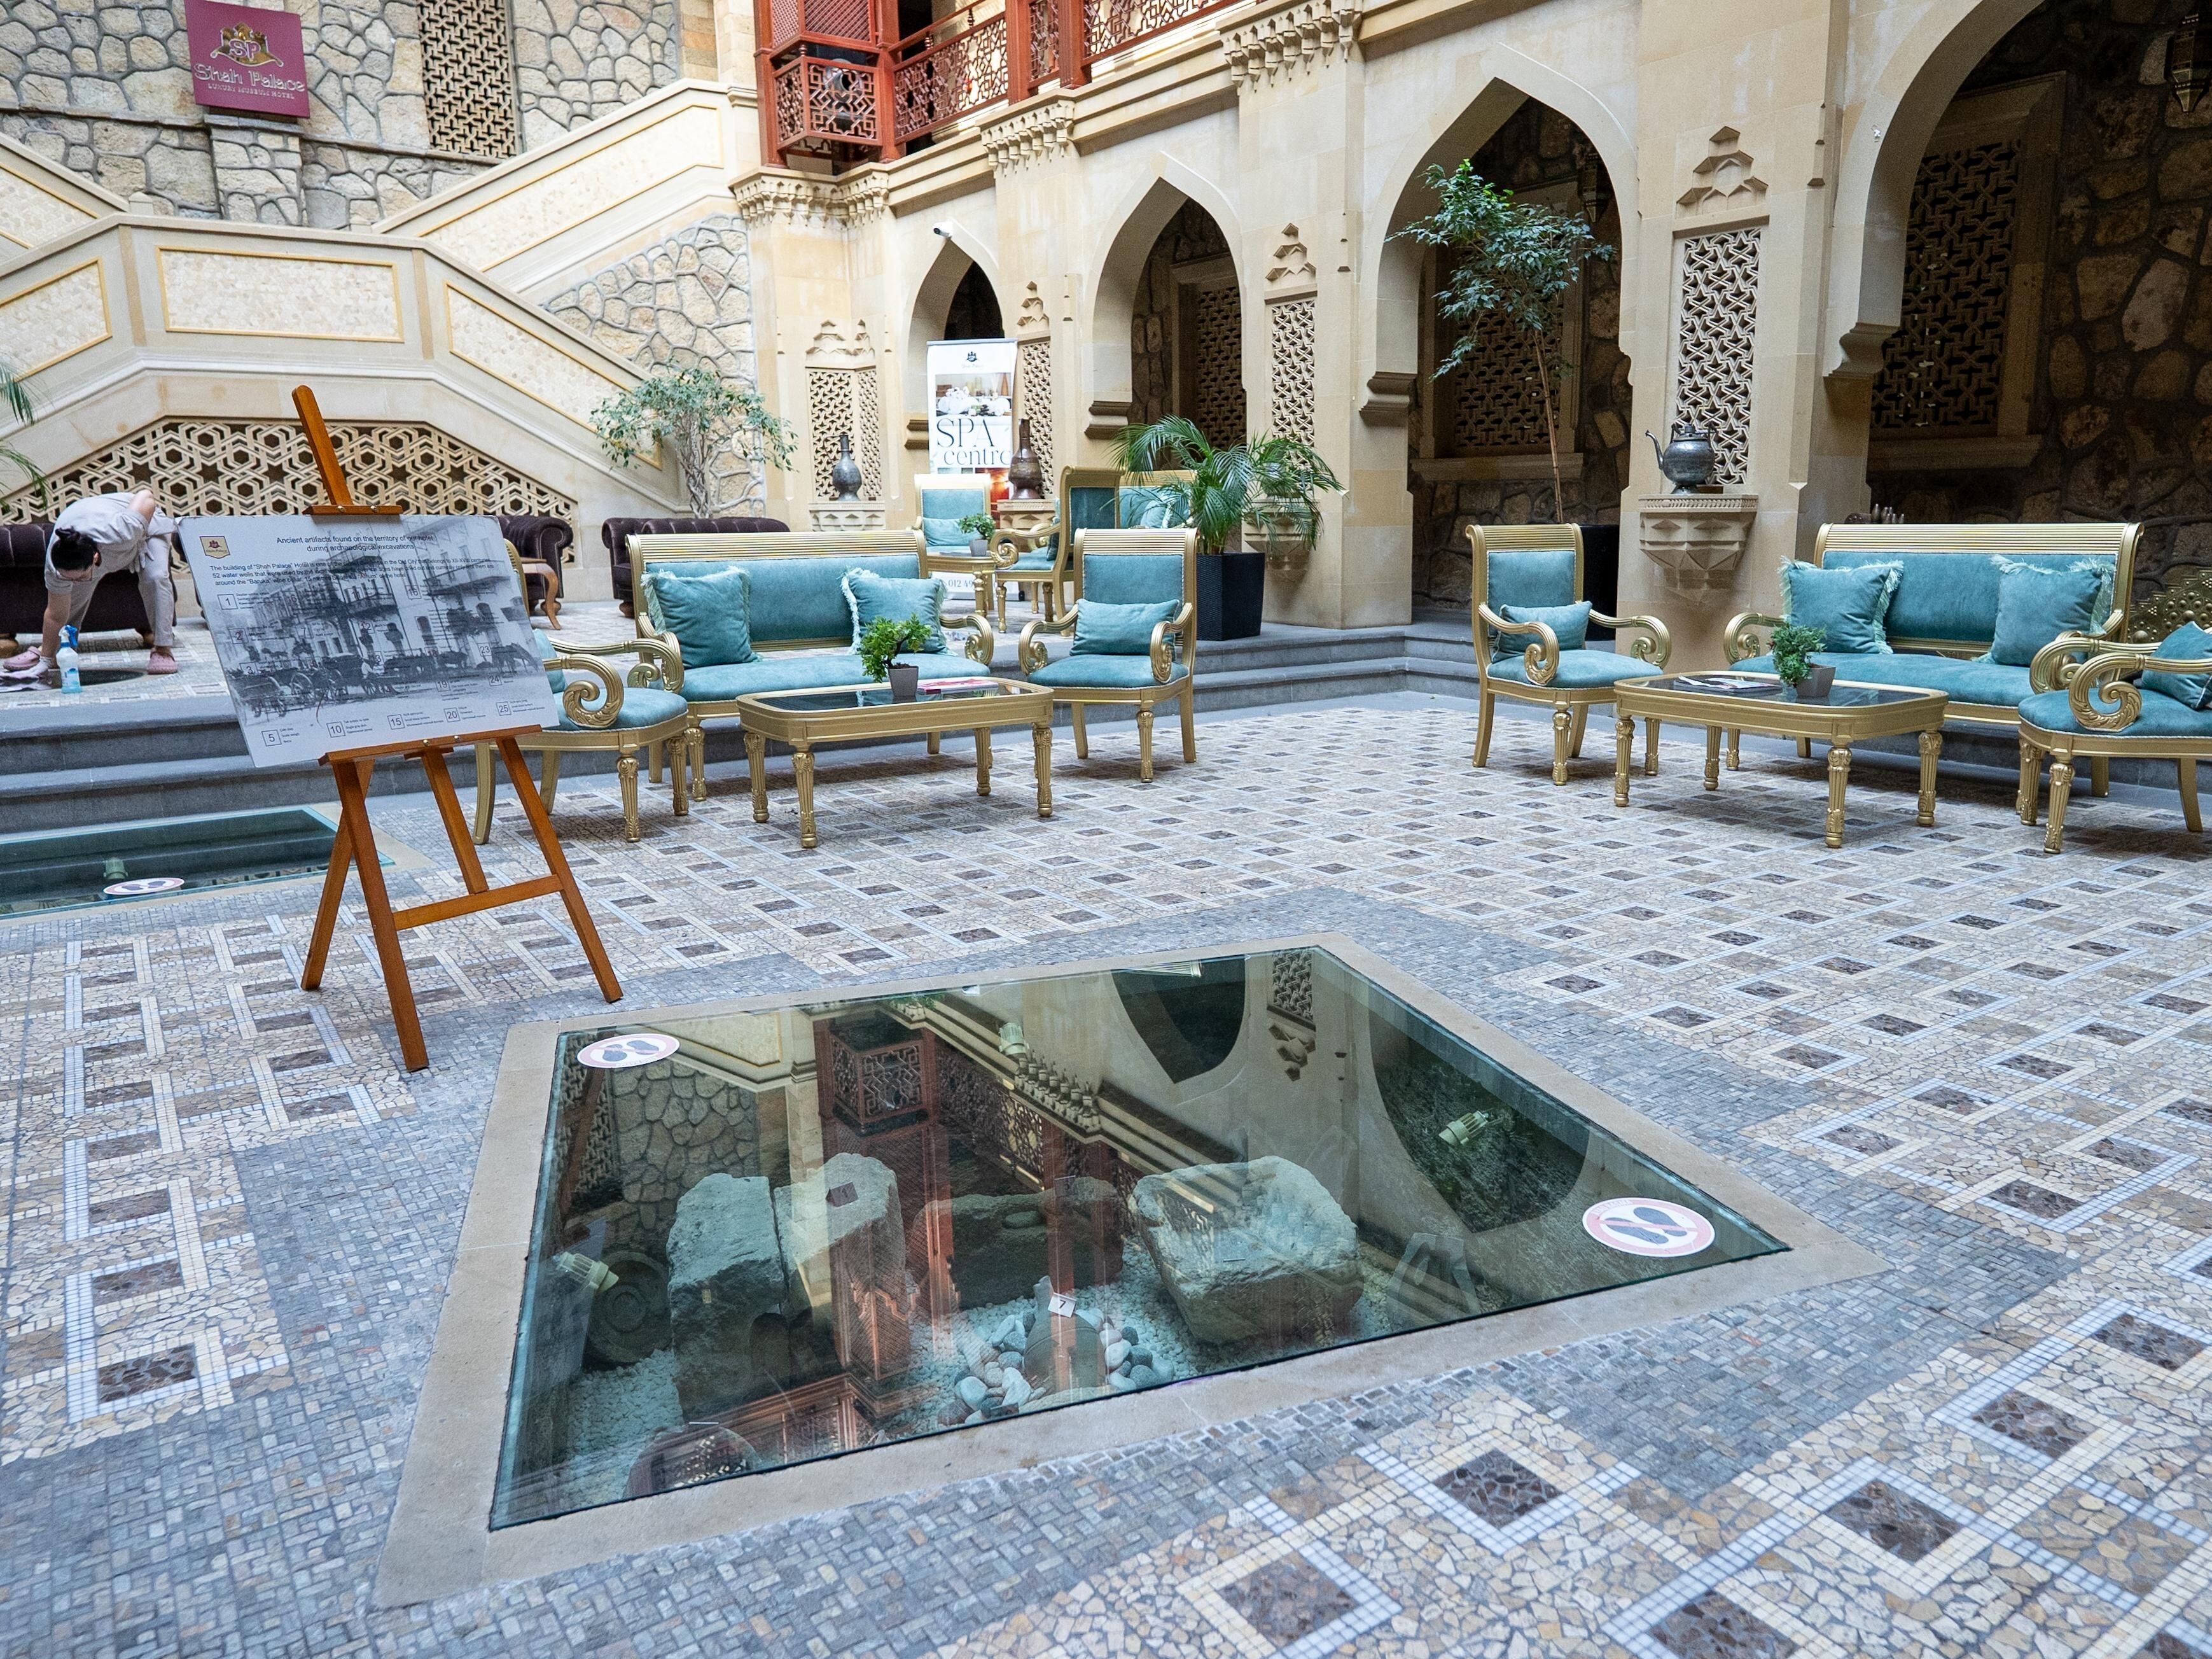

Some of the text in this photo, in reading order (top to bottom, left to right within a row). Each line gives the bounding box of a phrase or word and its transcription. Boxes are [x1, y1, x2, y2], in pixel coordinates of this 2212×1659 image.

[193, 64, 305, 92] Shah Palace
[271, 91, 295, 99] HOTEL
[936, 417, 996, 448] SPA
[943, 448, 1010, 466] centre
[948, 579, 974, 587] 012 49
[290, 594, 297, 603] 6
[235, 631, 242, 640] 2
[480, 645, 490, 654] 23
[246, 666, 254, 675] 3
[489, 675, 499, 683] 24
[438, 681, 447, 690] 19
[447, 711, 457, 719] 20
[391, 718, 401, 727] 15
[330, 725, 341, 734] 10
[268, 734, 275, 743] 5
[1059, 1299, 1066, 1309] 7
